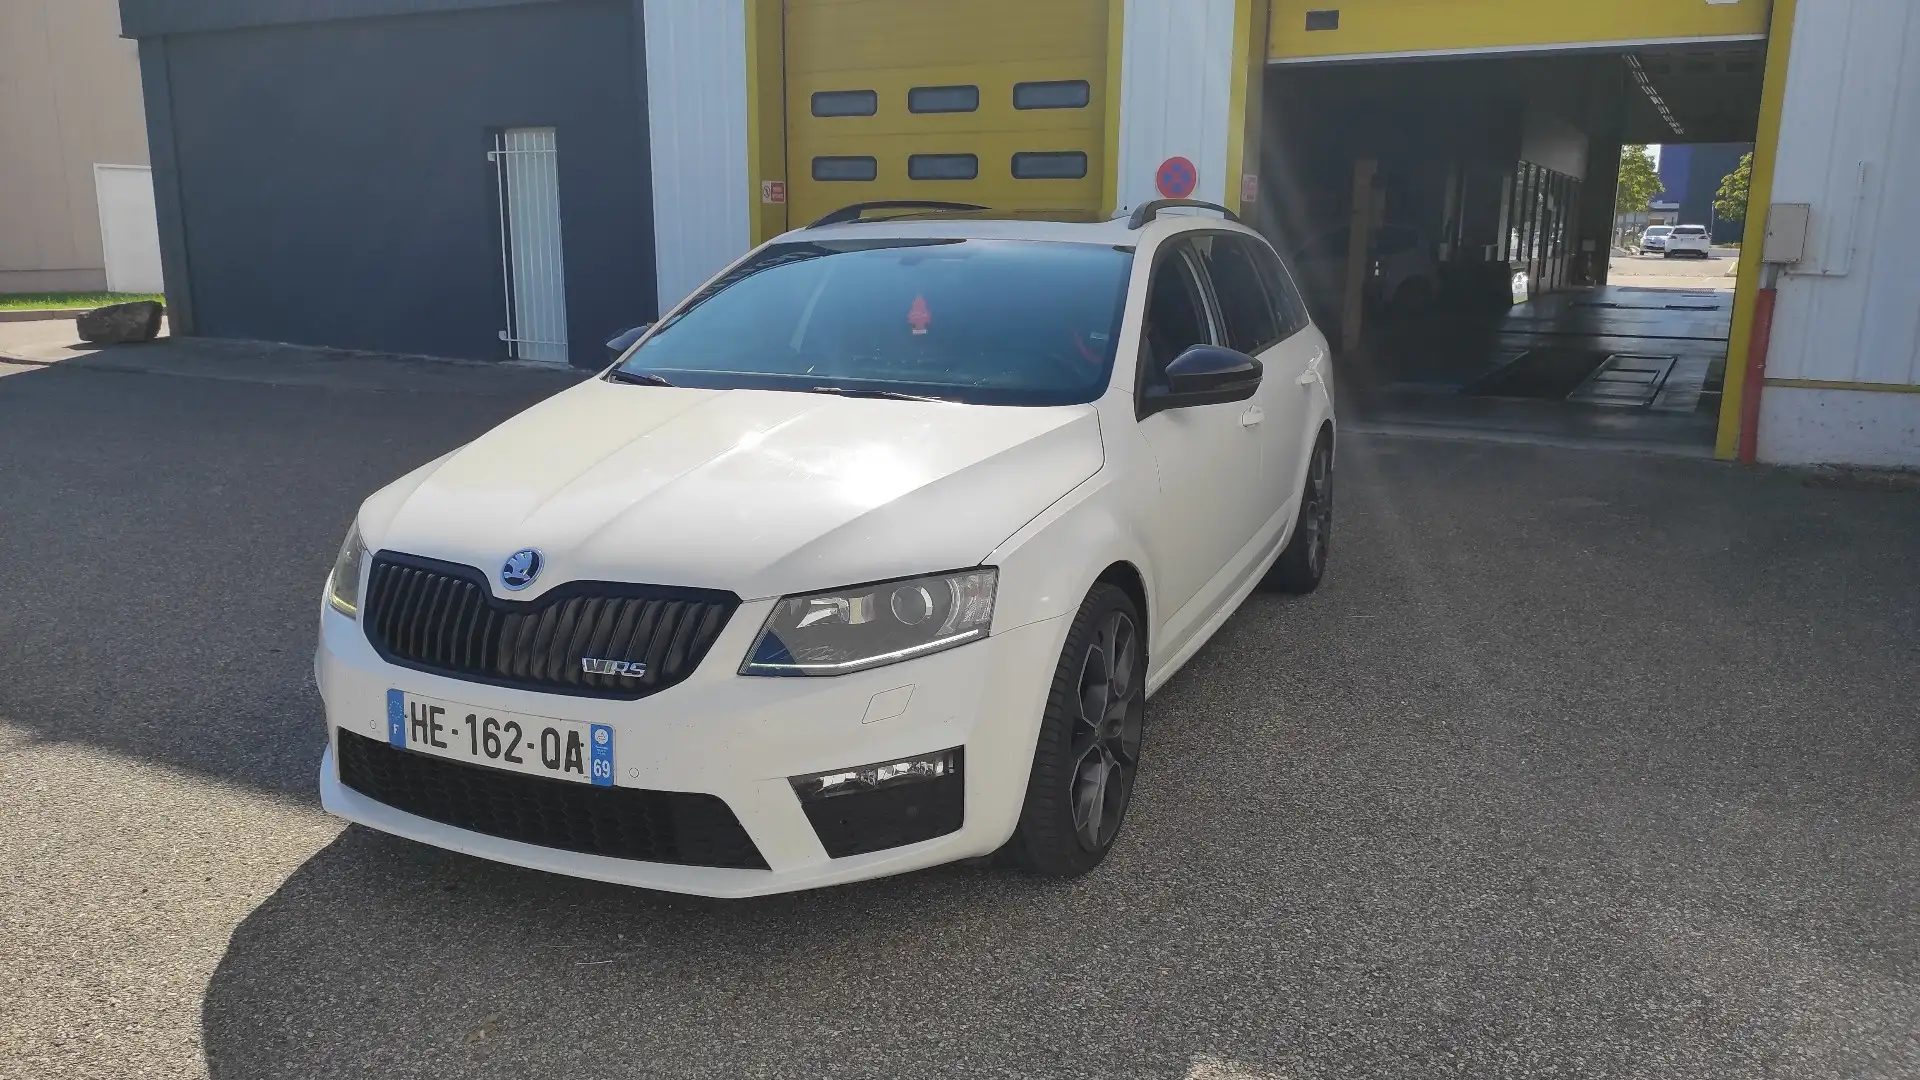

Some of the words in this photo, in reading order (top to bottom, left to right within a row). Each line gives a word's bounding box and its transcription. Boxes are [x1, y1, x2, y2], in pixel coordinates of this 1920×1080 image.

[393, 723, 399, 735] F
[411, 701, 584, 775] HE-162-QA
[593, 759, 610, 778] 69
